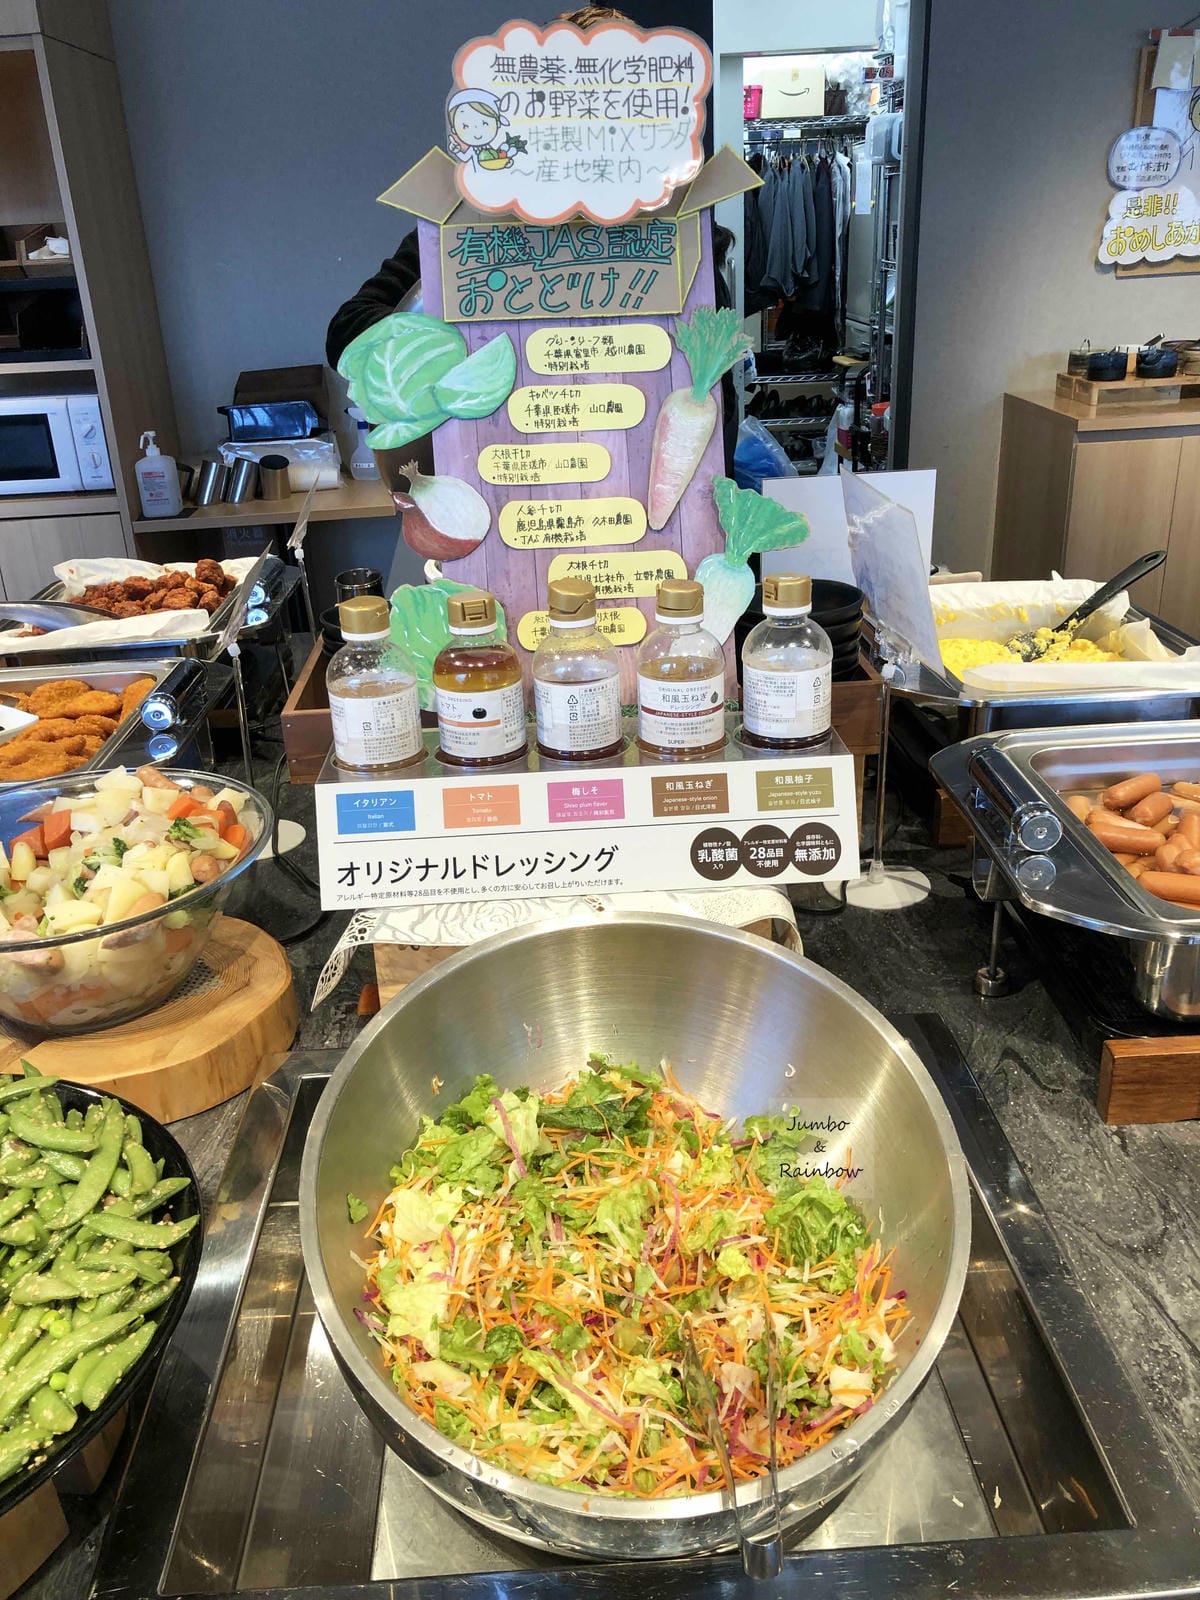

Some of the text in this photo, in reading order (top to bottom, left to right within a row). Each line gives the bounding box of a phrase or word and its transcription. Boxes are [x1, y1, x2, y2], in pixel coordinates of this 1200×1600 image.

[490, 52, 694, 85] 無農薬・無化学肥料
[448, 219, 677, 265] 有機JAS認定
[457, 267, 659, 316] おとどけ!!
[662, 692, 708, 703] 和風玉ねぎ
[665, 779, 713, 791] 和風玉ねぎ
[774, 774, 814, 785] 和風柚子
[469, 792, 494, 802] トマト
[572, 786, 599, 796] 梅しそ
[353, 798, 398, 808] イタリアン
[662, 796, 703, 804] Japanese-style
[697, 848, 738, 863] 乳酸菌
[749, 847, 784, 860] 28品目
[794, 847, 836, 862] 無添加
[337, 845, 619, 887] オリジナルドレッシング
[756, 860, 779, 868] 不使用
